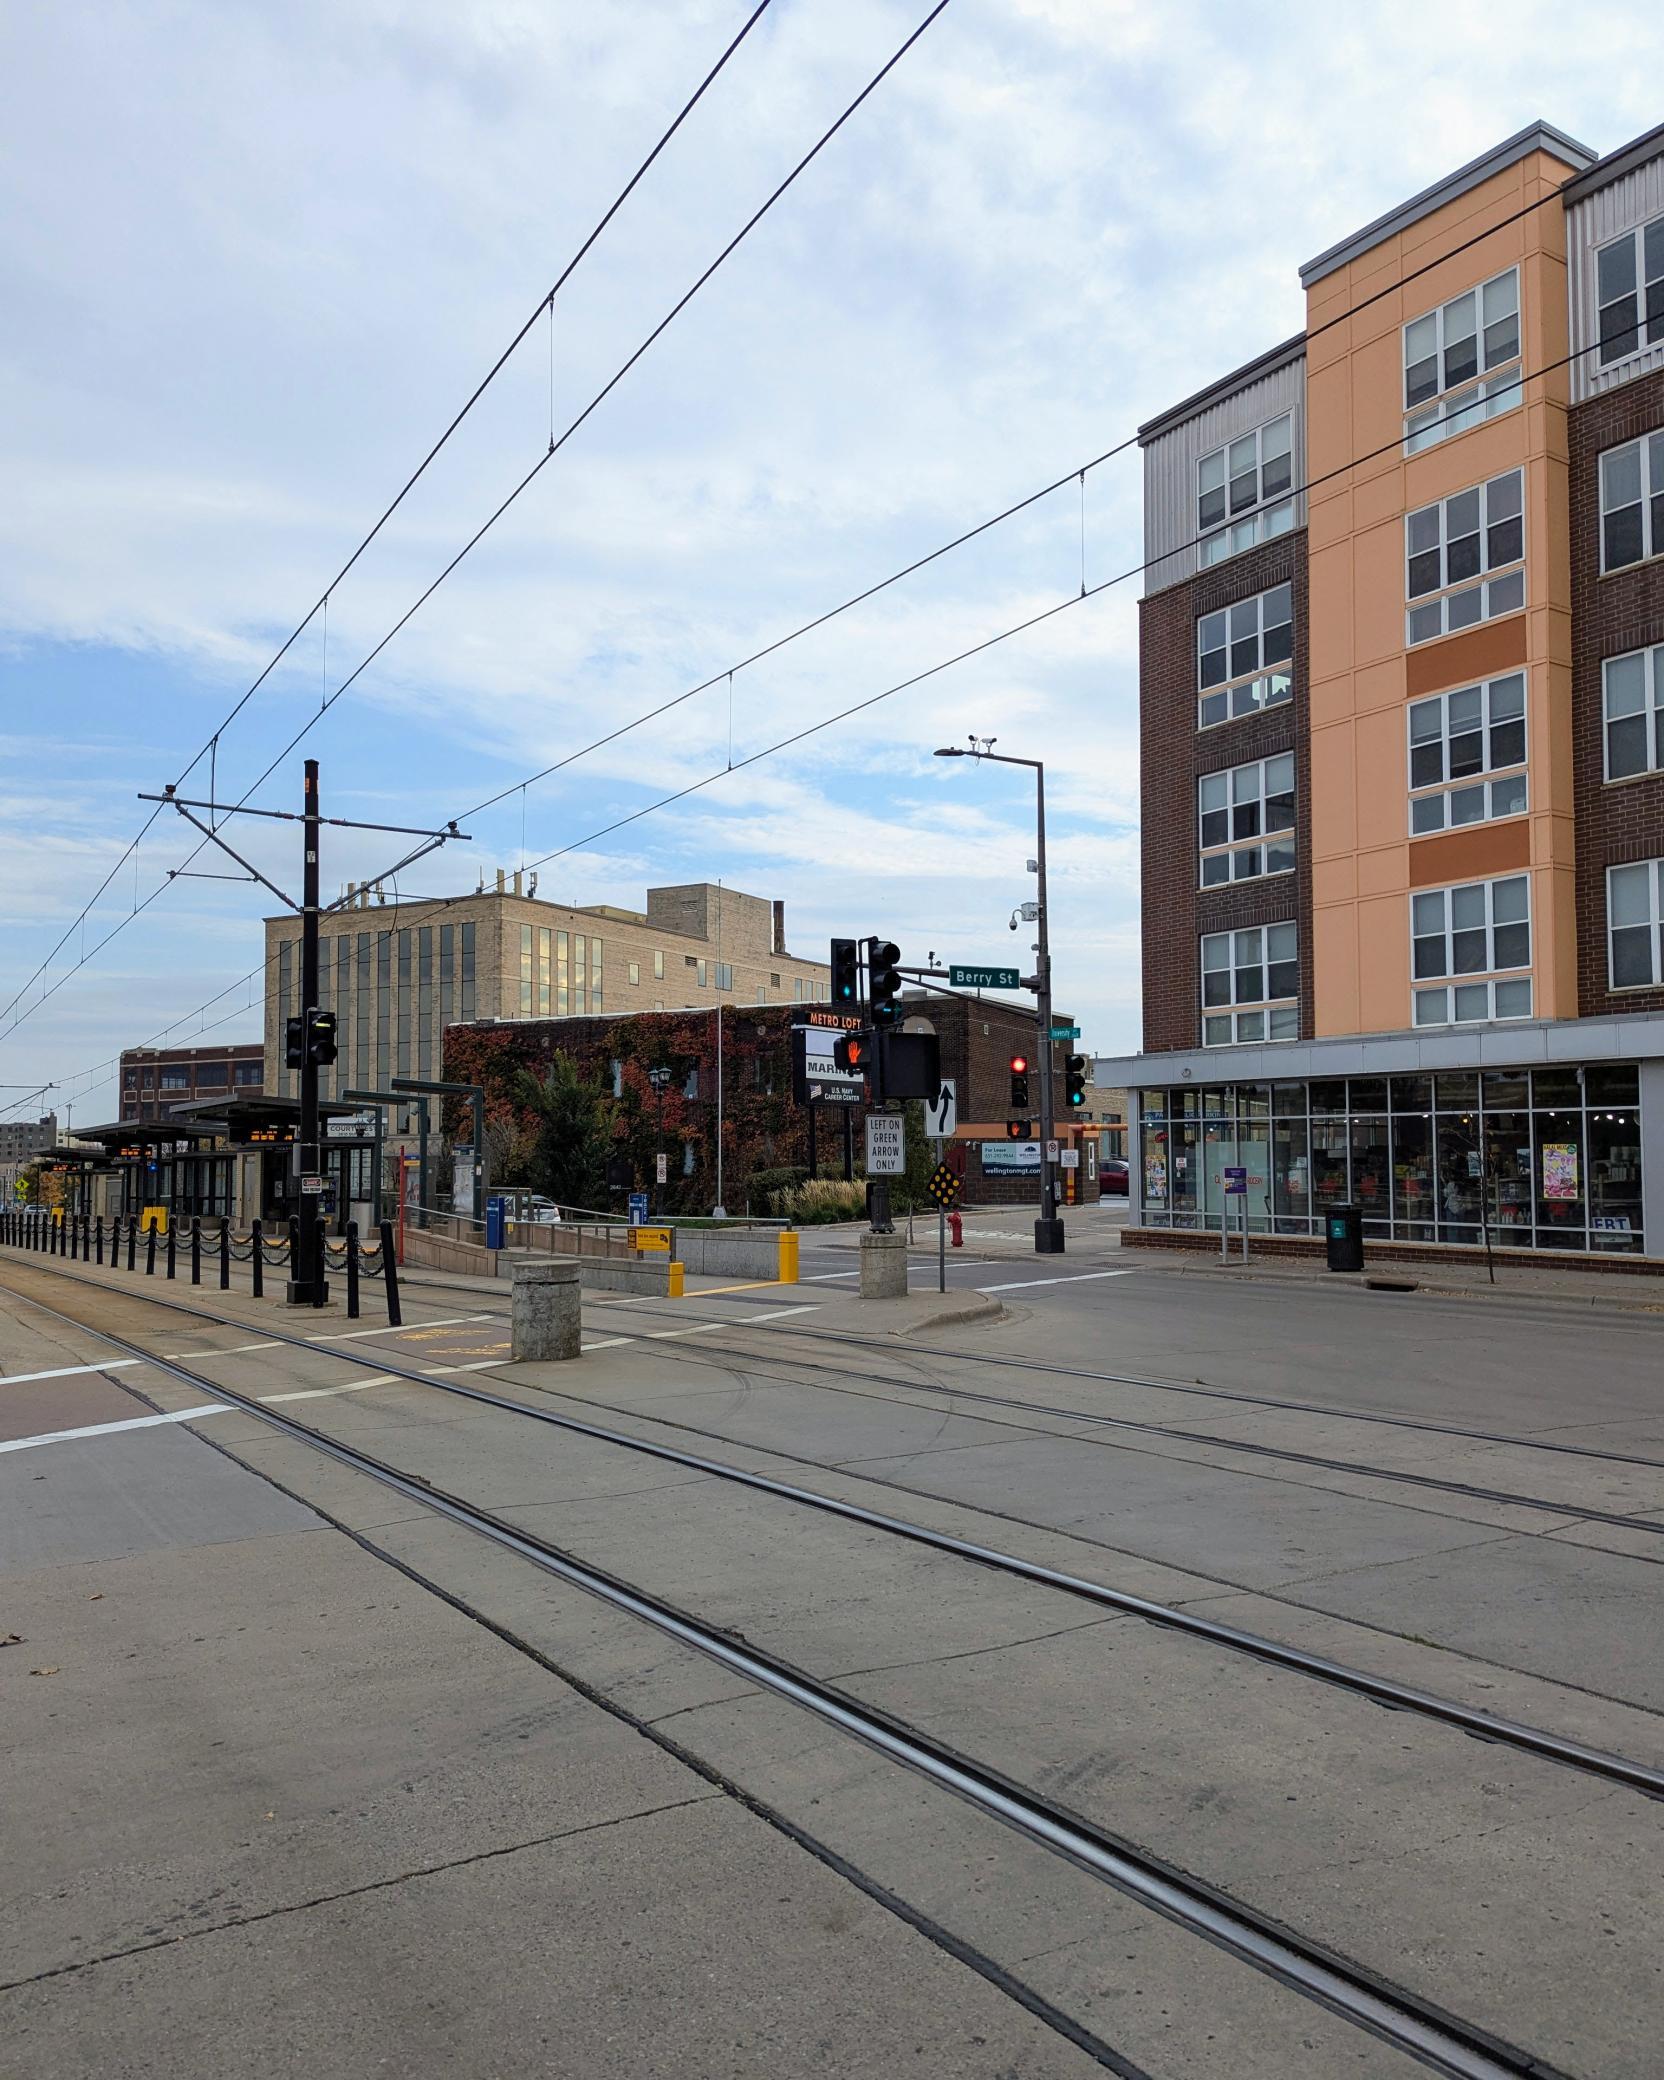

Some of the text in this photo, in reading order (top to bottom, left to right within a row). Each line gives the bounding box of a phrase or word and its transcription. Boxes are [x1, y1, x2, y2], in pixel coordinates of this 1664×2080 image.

[956, 971, 1013, 986] Berry St
[810, 1013, 839, 1027] METRO
[824, 1093, 842, 1101] CAREER
[870, 1120, 900, 1130] LEFT ON
[873, 1133, 898, 1143] GREEN
[872, 1146, 900, 1157] ARROW
[876, 1160, 896, 1170] ONLY
